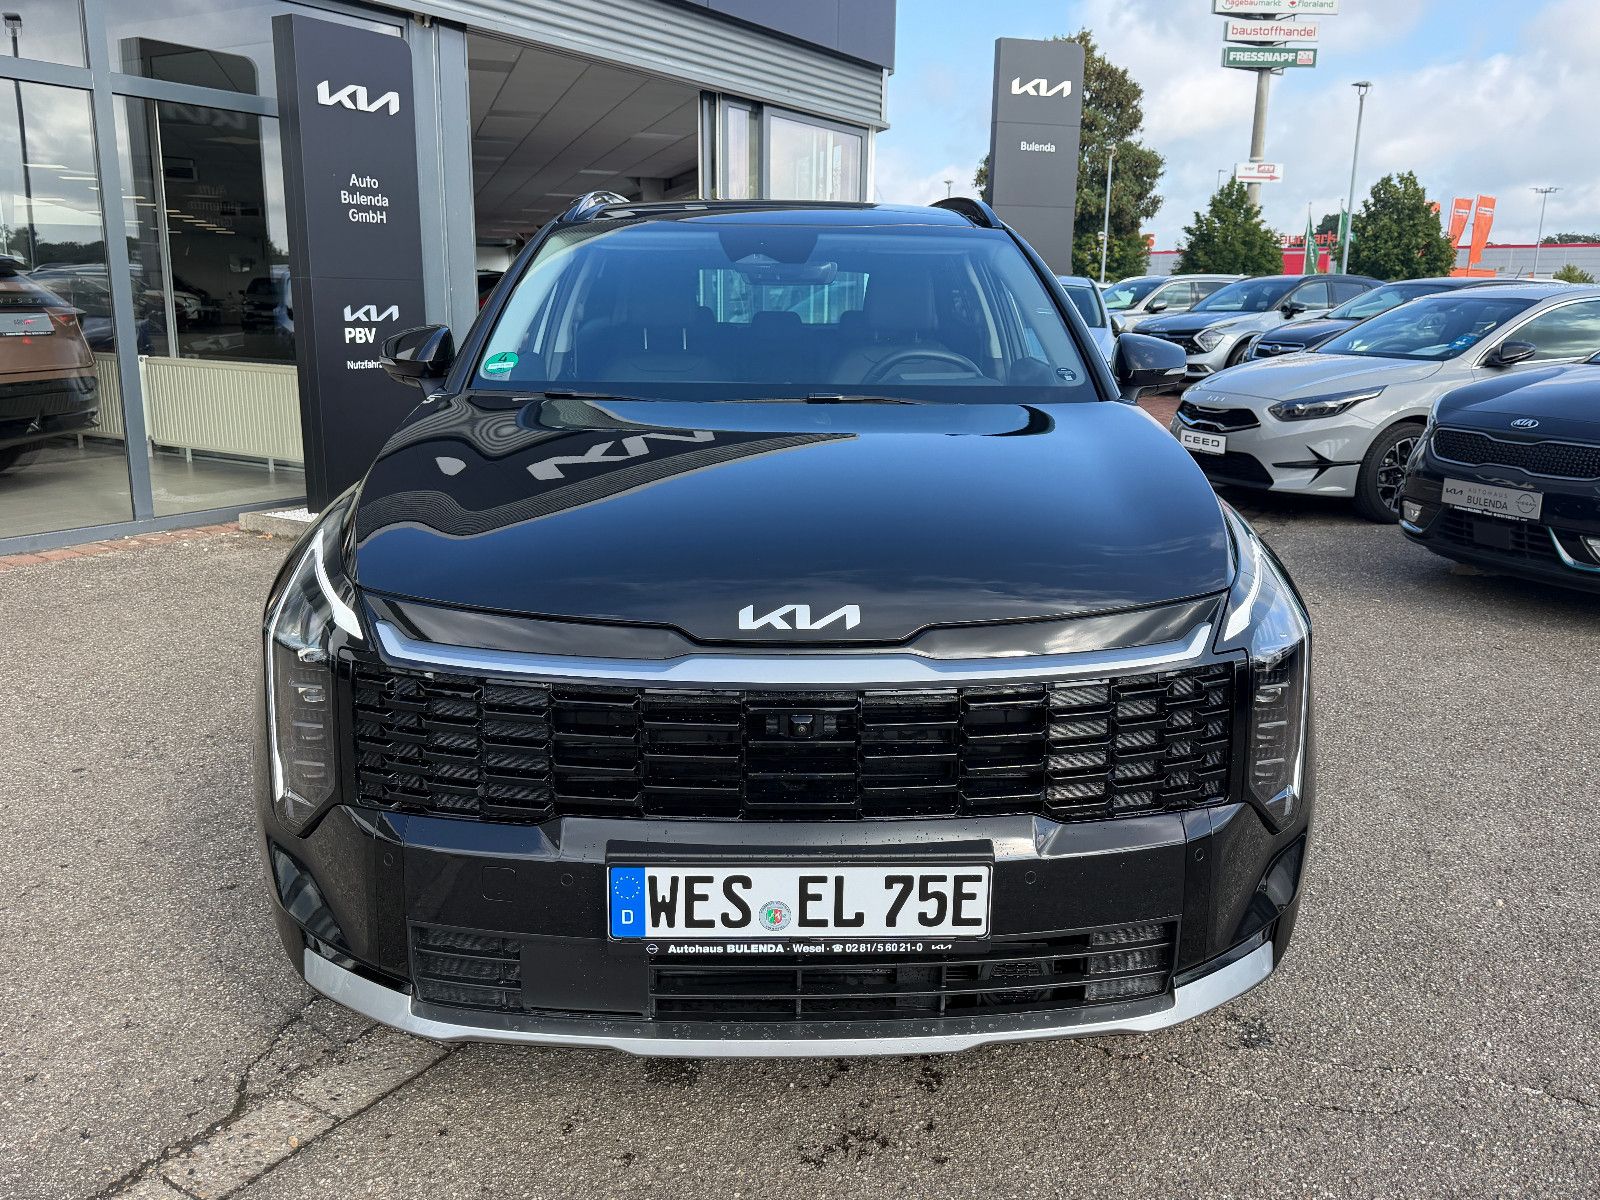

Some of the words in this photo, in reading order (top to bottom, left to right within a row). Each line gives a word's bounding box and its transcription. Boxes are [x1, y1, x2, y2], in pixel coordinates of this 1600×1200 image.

[1231, 25, 1316, 37] baustoffhandel
[1229, 51, 1296, 62] FRESSNAPF
[1020, 141, 1056, 152] Bulenda
[349, 173, 379, 188] Auto
[340, 191, 389, 207] Bulenda
[348, 209, 387, 224] GmbH
[344, 327, 376, 344] PBV
[1184, 435, 1220, 448] CEED
[1468, 488, 1508, 499] AUTOHAUS
[1466, 495, 1508, 510] BULENDA
[739, 604, 860, 630] KIA
[648, 875, 753, 929] WES
[798, 875, 865, 928] EL
[884, 875, 983, 928] 75E
[621, 910, 633, 924] D
[667, 944, 724, 953] Autohaus
[726, 944, 785, 953] BULENDA
[792, 943, 825, 952] Wesel
